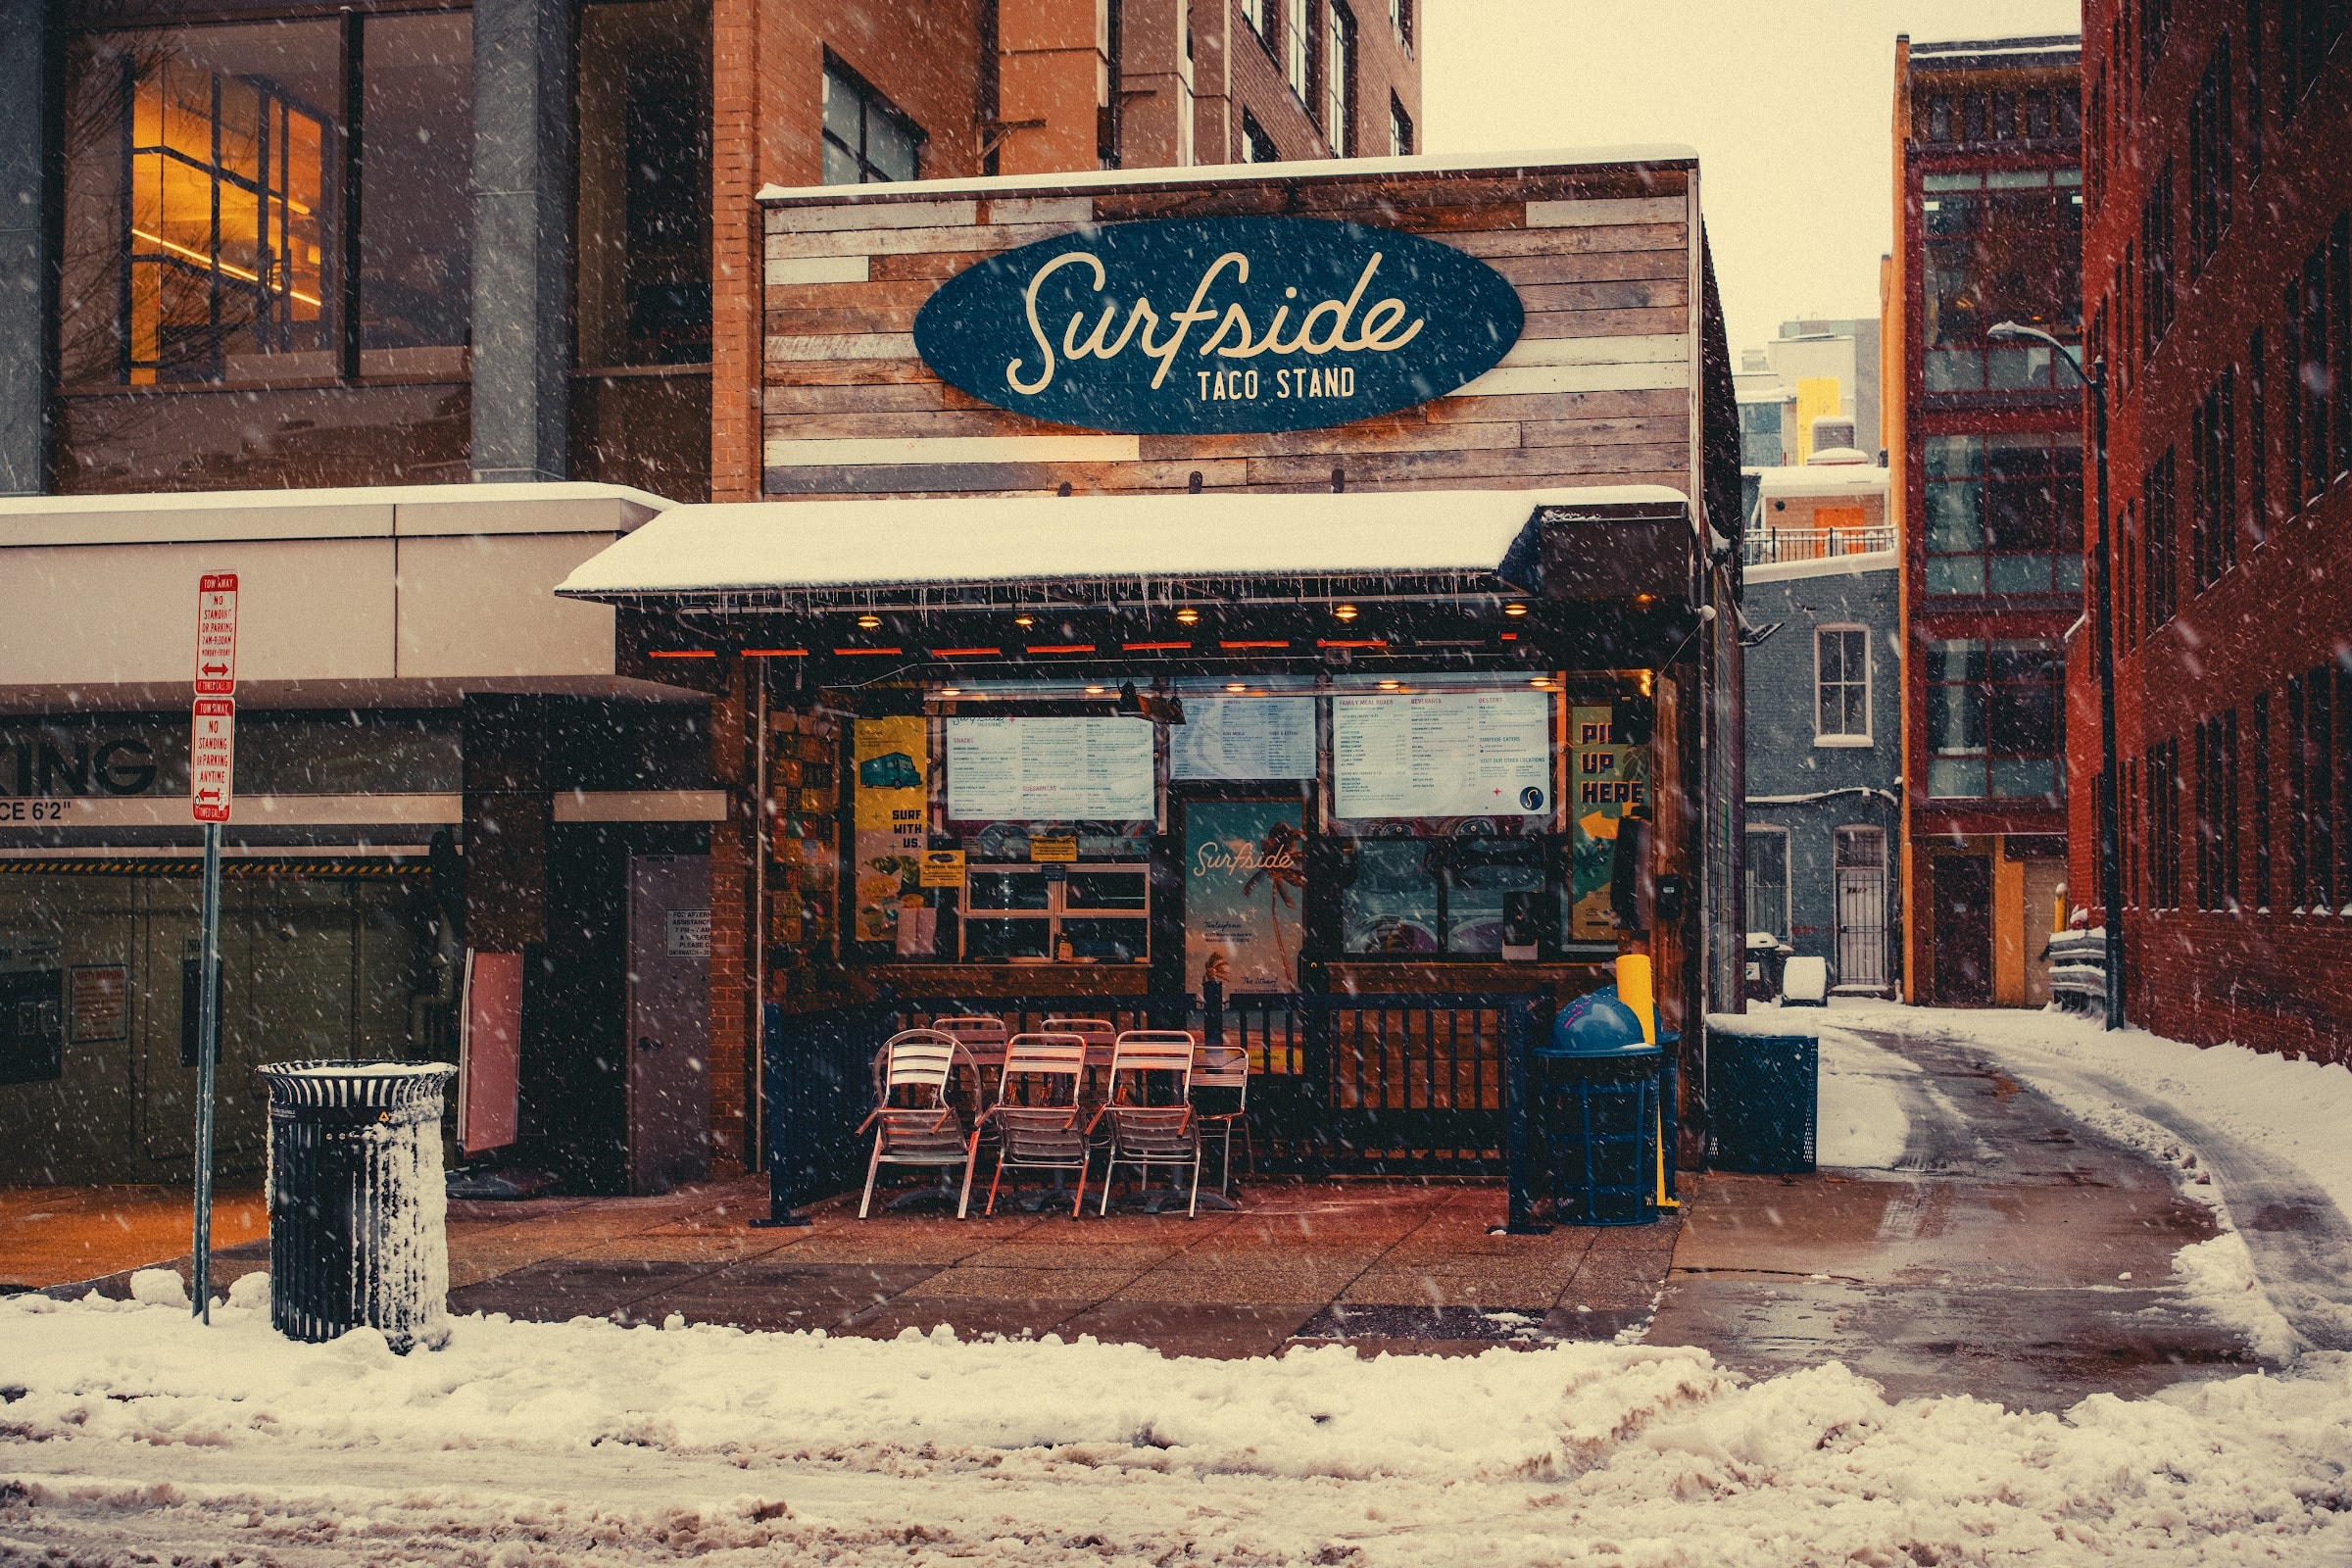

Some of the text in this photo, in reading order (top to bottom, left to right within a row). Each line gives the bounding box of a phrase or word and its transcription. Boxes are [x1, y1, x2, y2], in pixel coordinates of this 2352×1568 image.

[1006, 252, 1424, 394] Surfside
[1198, 367, 1354, 401] TACO STAND
[204, 578, 234, 589] TOW AWAY
[214, 595, 223, 605] NO
[204, 609, 231, 619] STANDING
[202, 622, 232, 632] OR PARKING
[200, 703, 212, 713] TOW
[209, 720, 219, 733] NO
[199, 737, 227, 751] STANDING
[197, 754, 228, 767] OR PARKING
[1580, 752, 1614, 773] UP
[199, 770, 225, 784] ANYTIME
[1580, 780, 1644, 804] HERE
[31, 801, 72, 820] 6'2"
[892, 809, 922, 820] SURF
[893, 823, 922, 834] WITH
[903, 837, 922, 849] US.
[1193, 841, 1295, 877] Surfside
